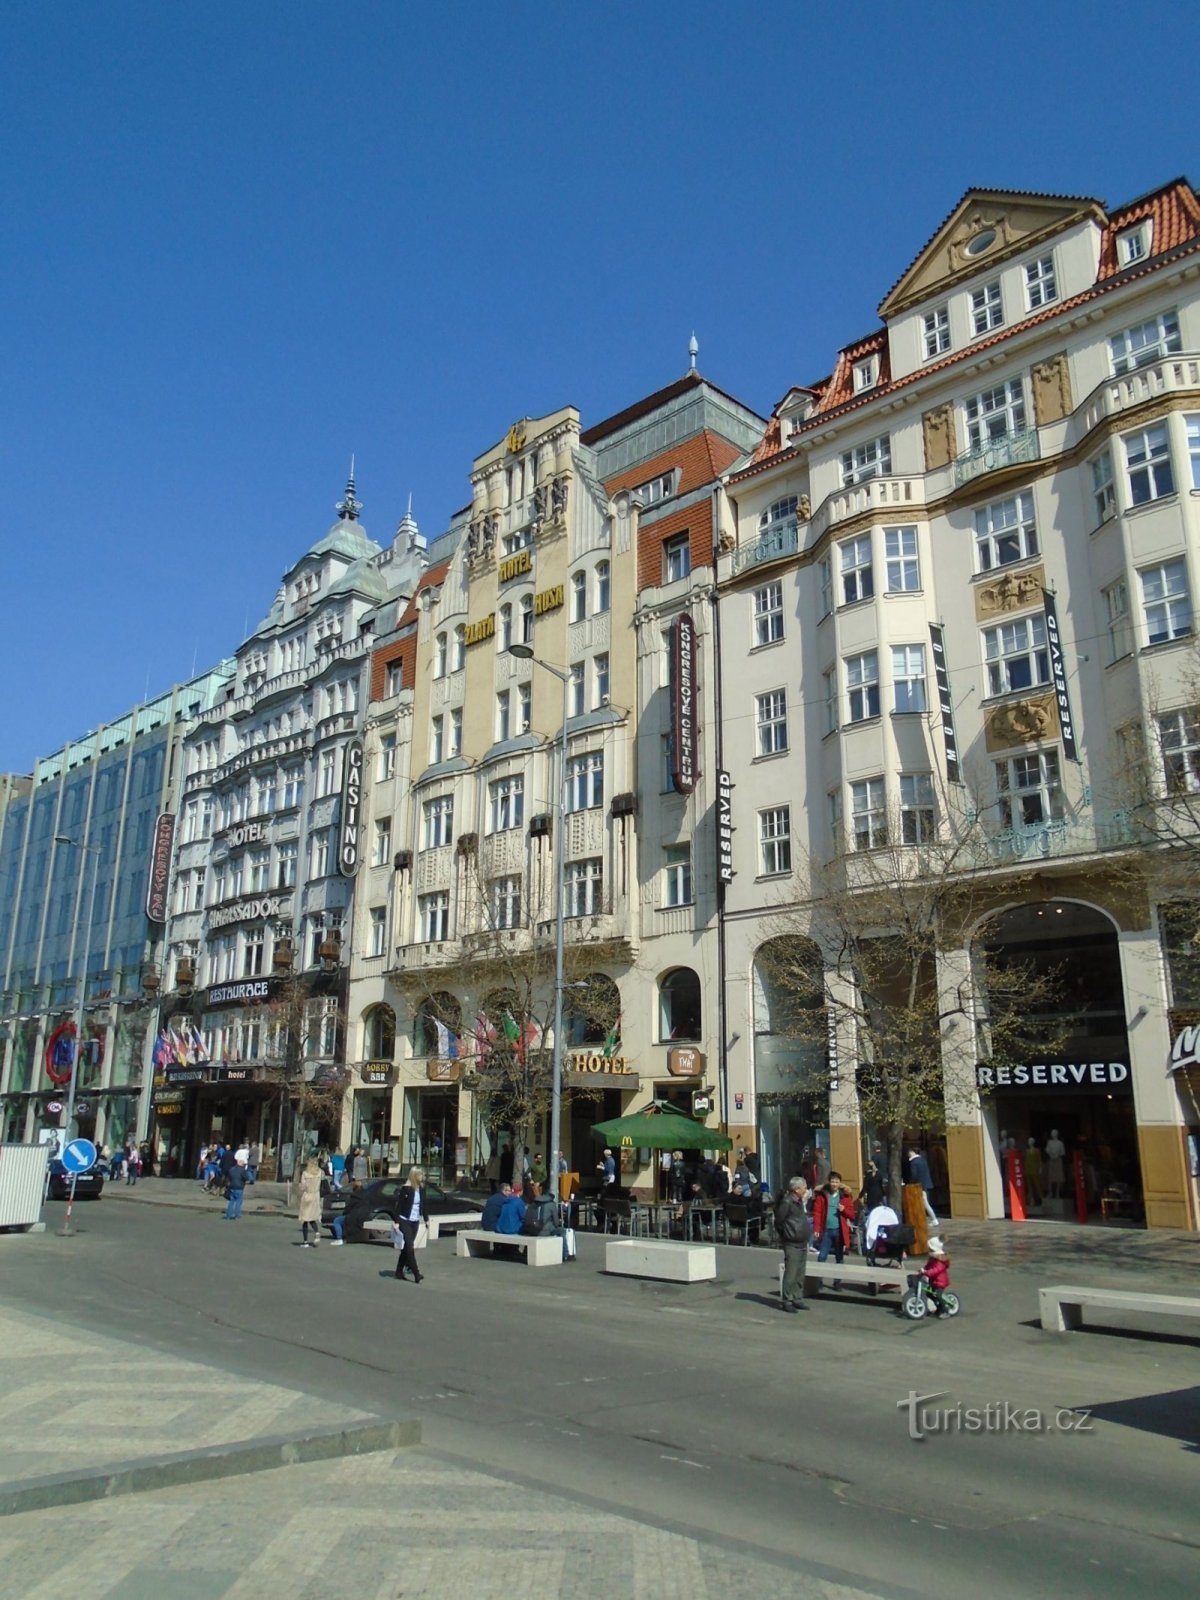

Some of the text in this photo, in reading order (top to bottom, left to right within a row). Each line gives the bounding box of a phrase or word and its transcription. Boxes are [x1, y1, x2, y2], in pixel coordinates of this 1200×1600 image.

[499, 550, 533, 584] HOTEL
[535, 584, 564, 617] HUSA
[1047, 615, 1073, 740] RESERVED
[932, 642, 957, 762] MOHITO
[681, 718, 693, 787] CENTRUM
[343, 748, 362, 865] CASINO
[227, 822, 267, 849] HOTEL
[719, 773, 732, 880] RESERVED
[207, 897, 281, 929] AMBASSADOR
[209, 981, 269, 1003] RESTAURACE
[575, 1055, 632, 1074] HOTEL
[977, 1062, 1128, 1086] RESERVED
